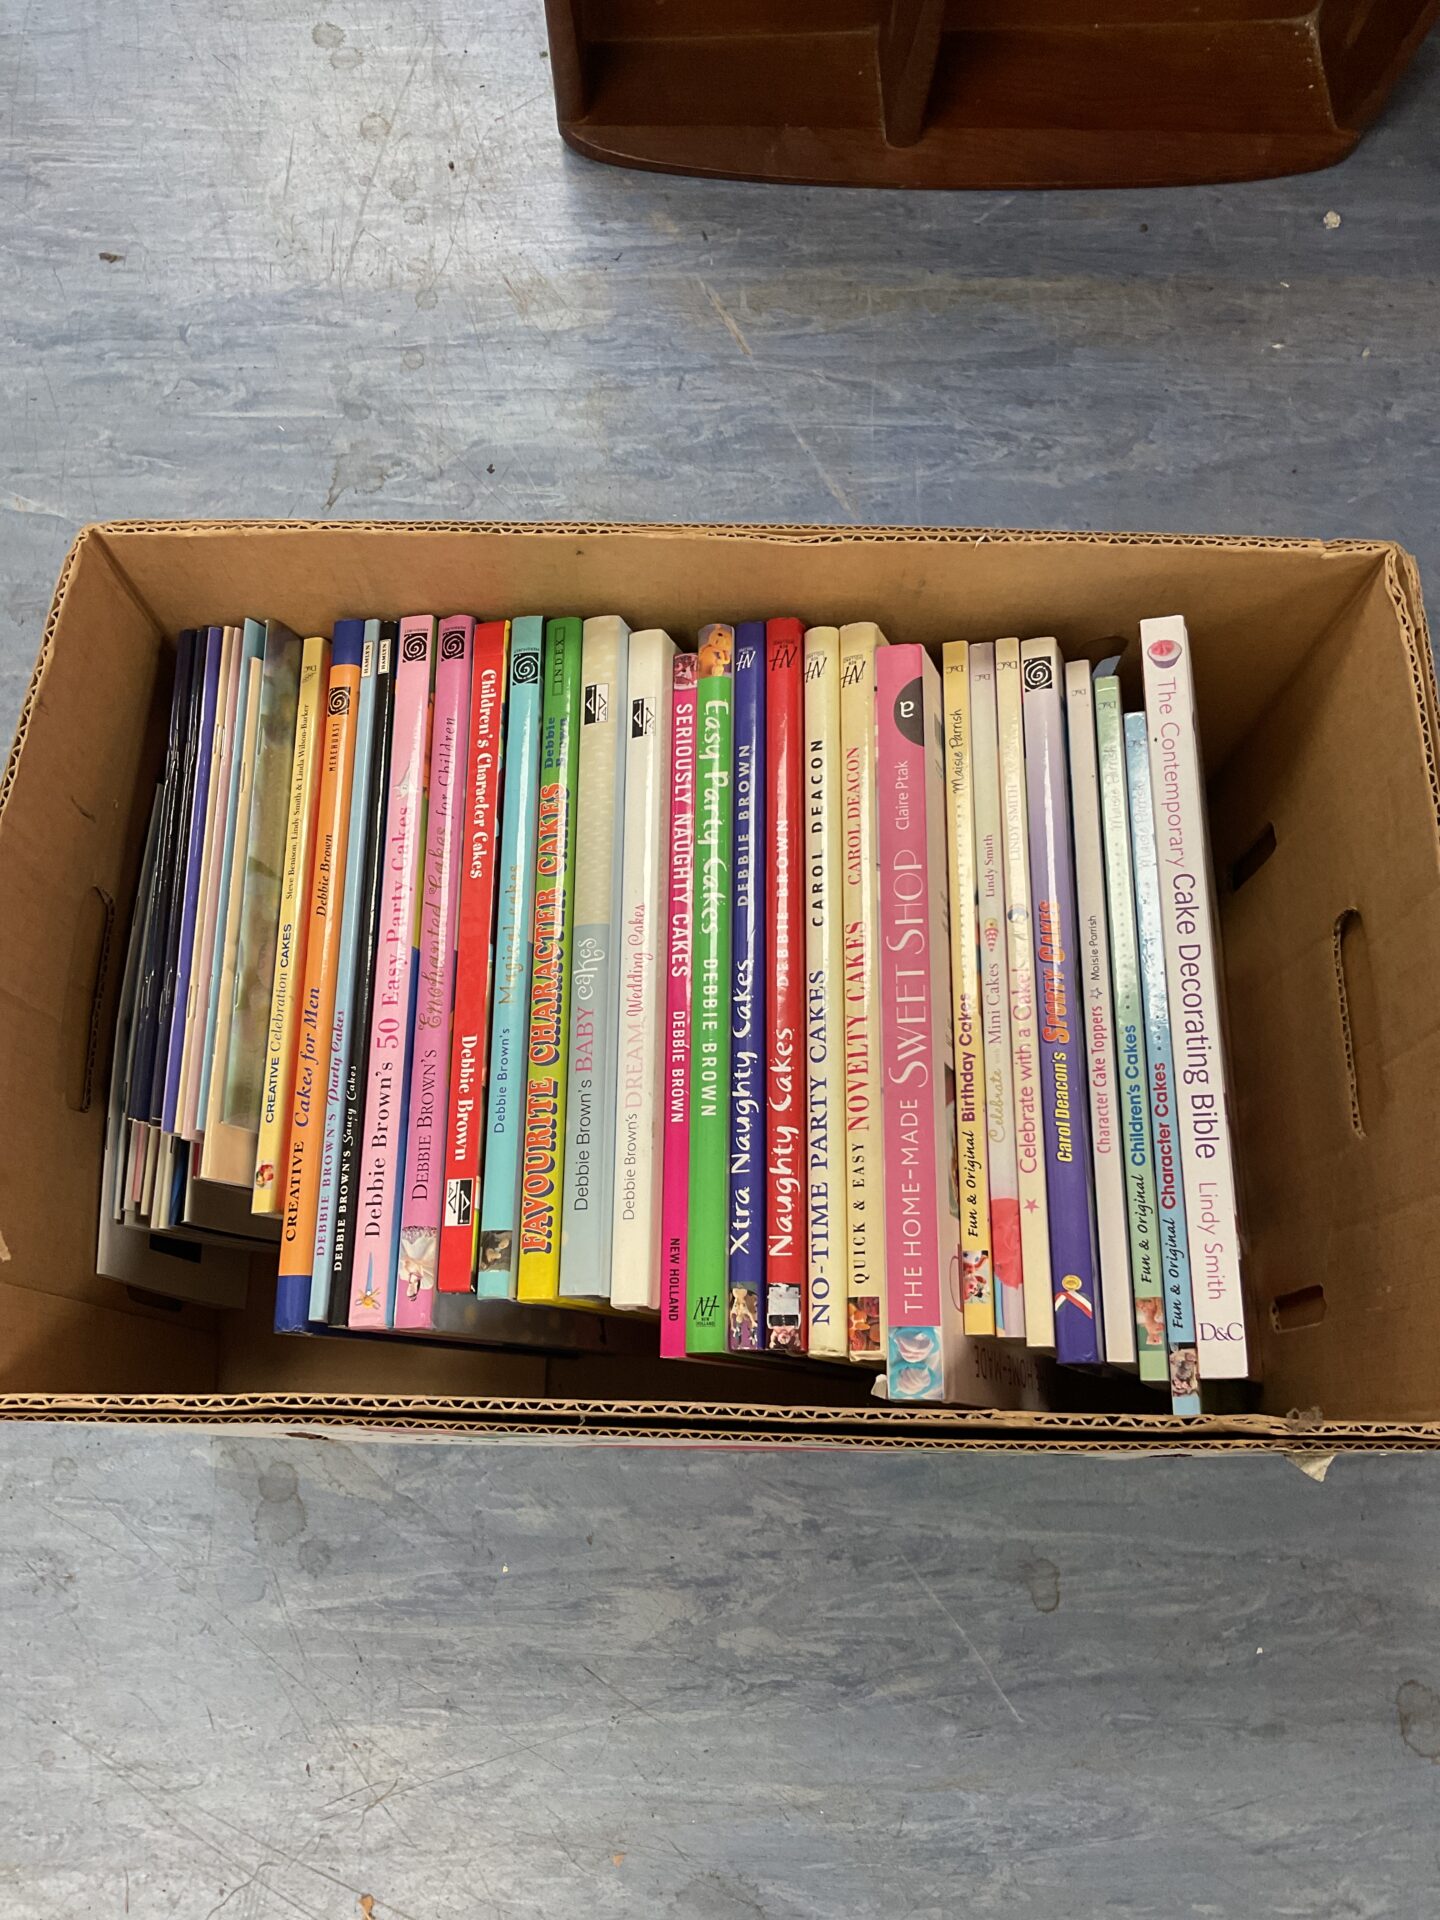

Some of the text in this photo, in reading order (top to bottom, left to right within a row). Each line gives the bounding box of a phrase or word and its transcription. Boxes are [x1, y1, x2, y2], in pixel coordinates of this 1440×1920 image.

[363, 644, 371, 674] HAMLYN
[380, 642, 388, 671] HAMLYN
[554, 638, 565, 684] INDEX
[295, 783, 303, 791] &
[296, 760, 306, 783] Linda
[298, 704, 310, 759] Wilson-Barker
[328, 722, 341, 773] MEREHURST
[469, 668, 497, 880] Children's Character Cakes
[544, 716, 556, 769] Debbie
[894, 759, 910, 831] Claire Ptak
[948, 708, 964, 795] Maisie Parrish
[290, 816, 300, 842] Lindy
[293, 792, 302, 816] Smith
[671, 703, 694, 978] SERIOUSLY NAUGHTY CAKES
[697, 699, 729, 935] Easy Party Cakes
[737, 744, 750, 907] DEBBIE BROWN
[810, 739, 825, 927] CAROL DEACON
[846, 746, 862, 886] CAROL DEACON
[983, 834, 997, 898] Lindy Smith
[1005, 783, 1019, 824] SMITH
[286, 879, 294, 900] Steve
[316, 834, 333, 917] Debbie Brown
[776, 820, 789, 988] DEBBIE BROWN
[1157, 676, 1220, 1159] The Contemporary Cake Decorating Bible
[411, 716, 456, 1201] DEBBIE BROWN'S Enchanted Cakes for Children
[498, 926, 524, 1005] Magical
[1088, 914, 1101, 982] Maisie Parrish
[265, 923, 292, 1123] CREATIVE Celebration CAKES
[364, 806, 413, 1237] Debbie Brown's 50 Easy Party Cakes
[497, 1028, 510, 1081] Brown's
[521, 782, 570, 1254] FAVOURITE CHARACTER CAKES
[573, 937, 606, 1211] Debbie Brown's BABY cakes
[622, 903, 654, 1221] Debbie Brown's DREAM Wedding Cakes
[670, 1011, 686, 1124] DEBBIE BROWN
[701, 958, 719, 1117] DEBBIE BROWN
[845, 920, 870, 1132] NOVELTY CAKES
[885, 848, 929, 1315] THE HOME-MADE SWEET SHOP
[985, 962, 1006, 1143] Celebrate Mini Cakes
[1014, 1043, 1033, 1081] with
[1018, 1027, 1032, 1038] a
[1091, 1006, 1111, 1155] Character Cake Toppers
[285, 986, 320, 1242] CREATIVE Cakes for Men
[316, 1009, 345, 1257] DEBBIE BROWN'S Party Cakes
[454, 1034, 478, 1161] Debbie Brown
[494, 1085, 506, 1133] Debbie
[729, 958, 760, 1256] Xtra Naughty Cakes
[768, 1027, 800, 1257] Naughty Cakes
[808, 970, 830, 1326] NO-TIME PARTY CAKES
[957, 993, 982, 1238] Fun & Original Birthday Cakes
[1018, 1086, 1037, 1174] Celebrate
[1052, 1051, 1070, 1119] Deacon's
[1056, 1119, 1074, 1163] Carol
[333, 1064, 358, 1272] DEBBIE BROWN'S Saucy Cakes
[852, 1143, 870, 1285] QUICK & EASY
[1124, 1024, 1154, 1284] Fun & Original Children's Cakes
[1153, 1062, 1185, 1329] Fun & Original Character Cakes
[668, 1237, 681, 1322] NEW HOLLAND
[1196, 1182, 1228, 1300] Lindy Smith
[1199, 1322, 1244, 1342] D&C
